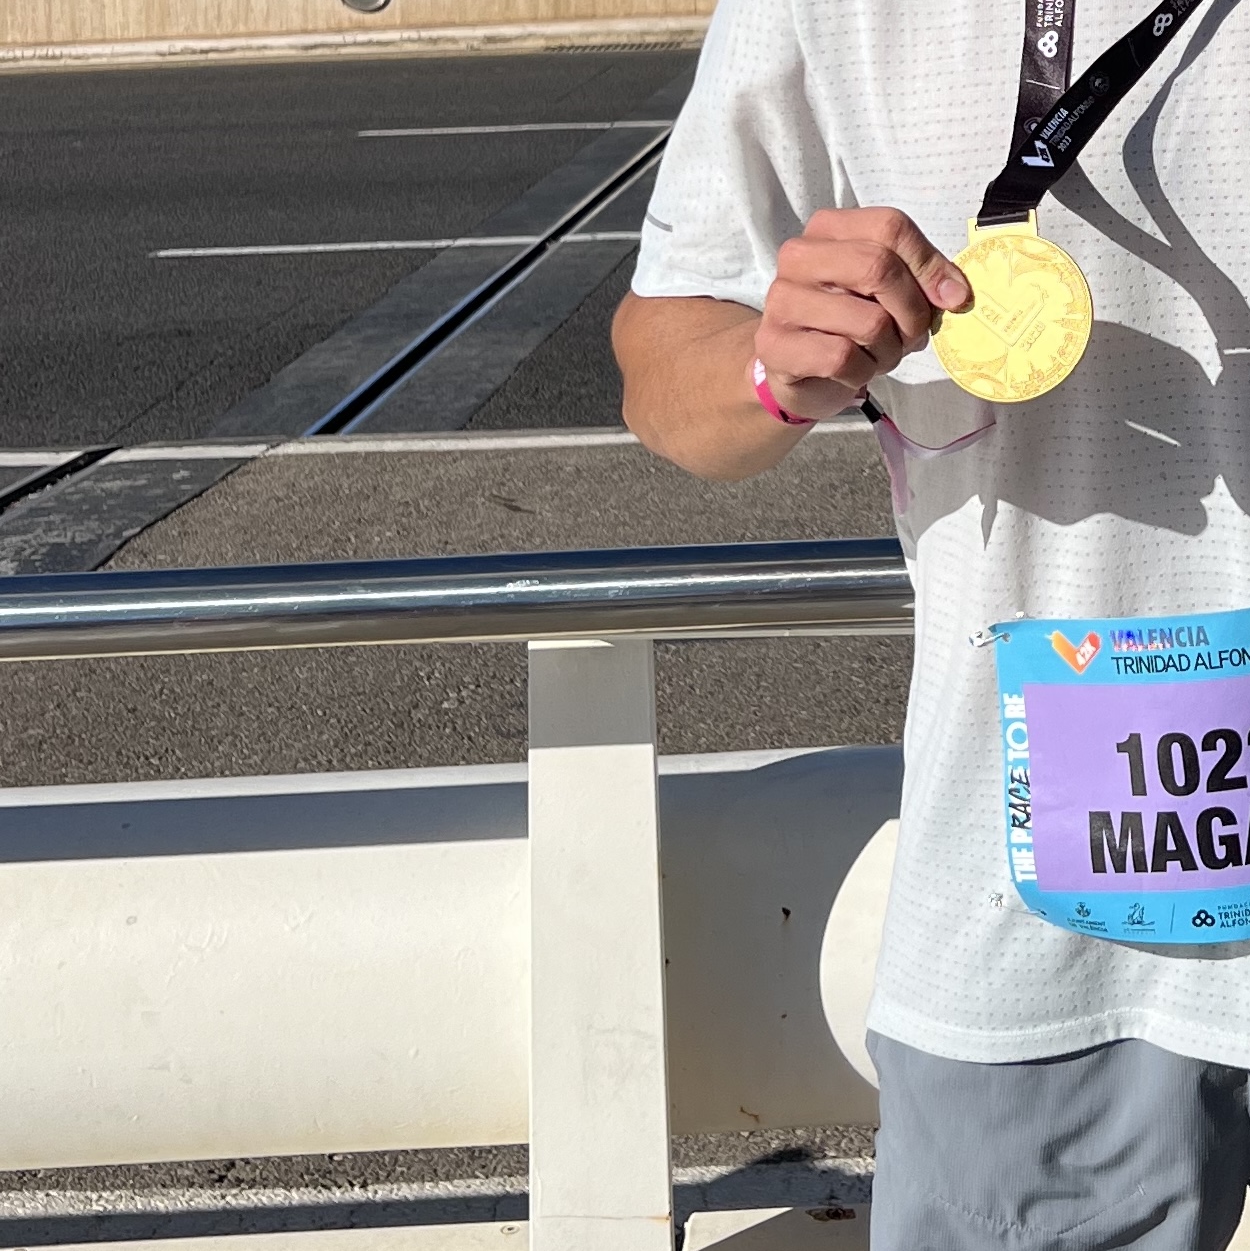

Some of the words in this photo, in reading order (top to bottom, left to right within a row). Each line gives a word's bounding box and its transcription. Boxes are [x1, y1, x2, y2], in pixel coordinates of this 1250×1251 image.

[1039, 107, 1069, 140] VALENCIA
[1110, 626, 1210, 652] VALENCIA
[1111, 653, 1191, 675] TRINIDAD
[1003, 693, 1026, 718] BE
[1006, 721, 1030, 762] TO
[1011, 846, 1037, 882] THE
